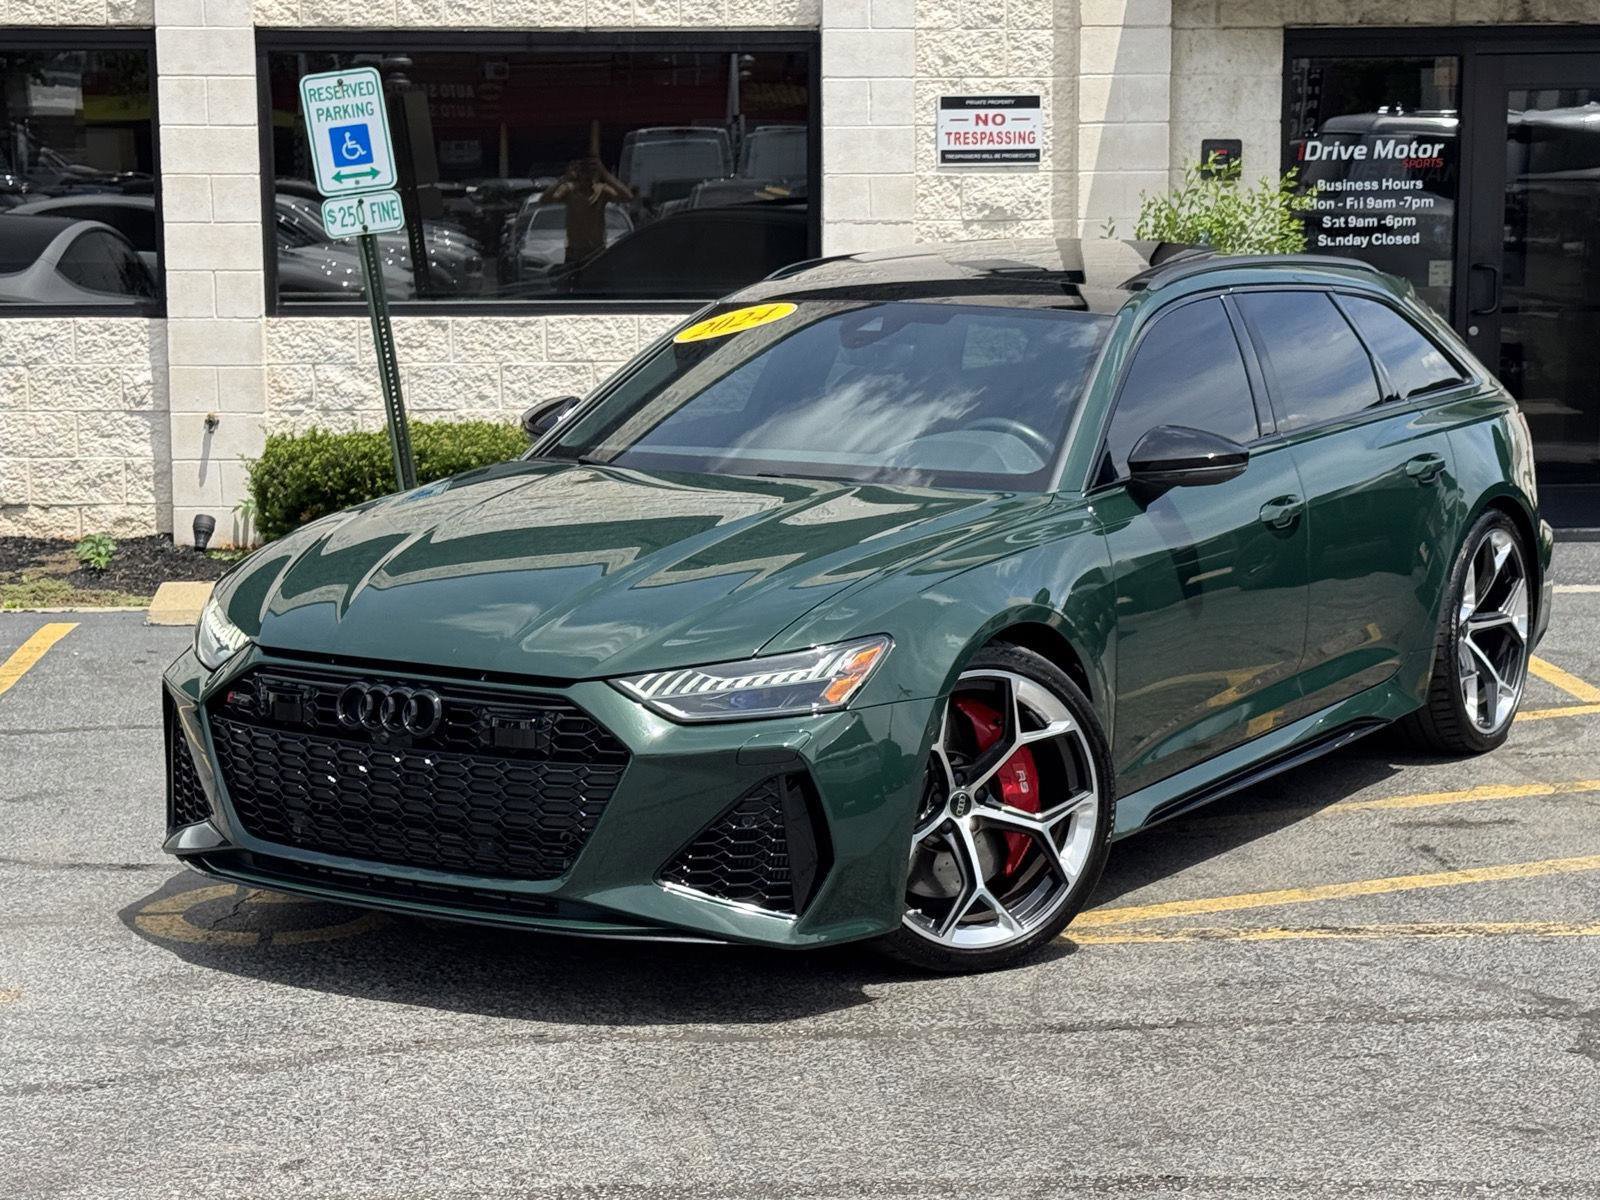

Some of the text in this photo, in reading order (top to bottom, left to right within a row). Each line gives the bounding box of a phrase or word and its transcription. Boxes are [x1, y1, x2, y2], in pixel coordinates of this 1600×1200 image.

[308, 80, 376, 103] RESERVED
[316, 101, 375, 123] PARKING
[974, 113, 1006, 127] NO
[945, 130, 1036, 145] TRESPASSING
[1373, 139, 1445, 160] Motor
[1402, 157, 1445, 169] SPORTS
[1317, 178, 1423, 191] Business Hours
[1366, 197, 1396, 209] 9am
[326, 200, 400, 228] $250 FINE
[1322, 215, 1346, 228] Sat
[1348, 215, 1378, 228] 9am
[1317, 232, 1420, 248] Sunday Closed
[687, 305, 781, 340] 2024
[1016, 769, 1029, 794] RS
